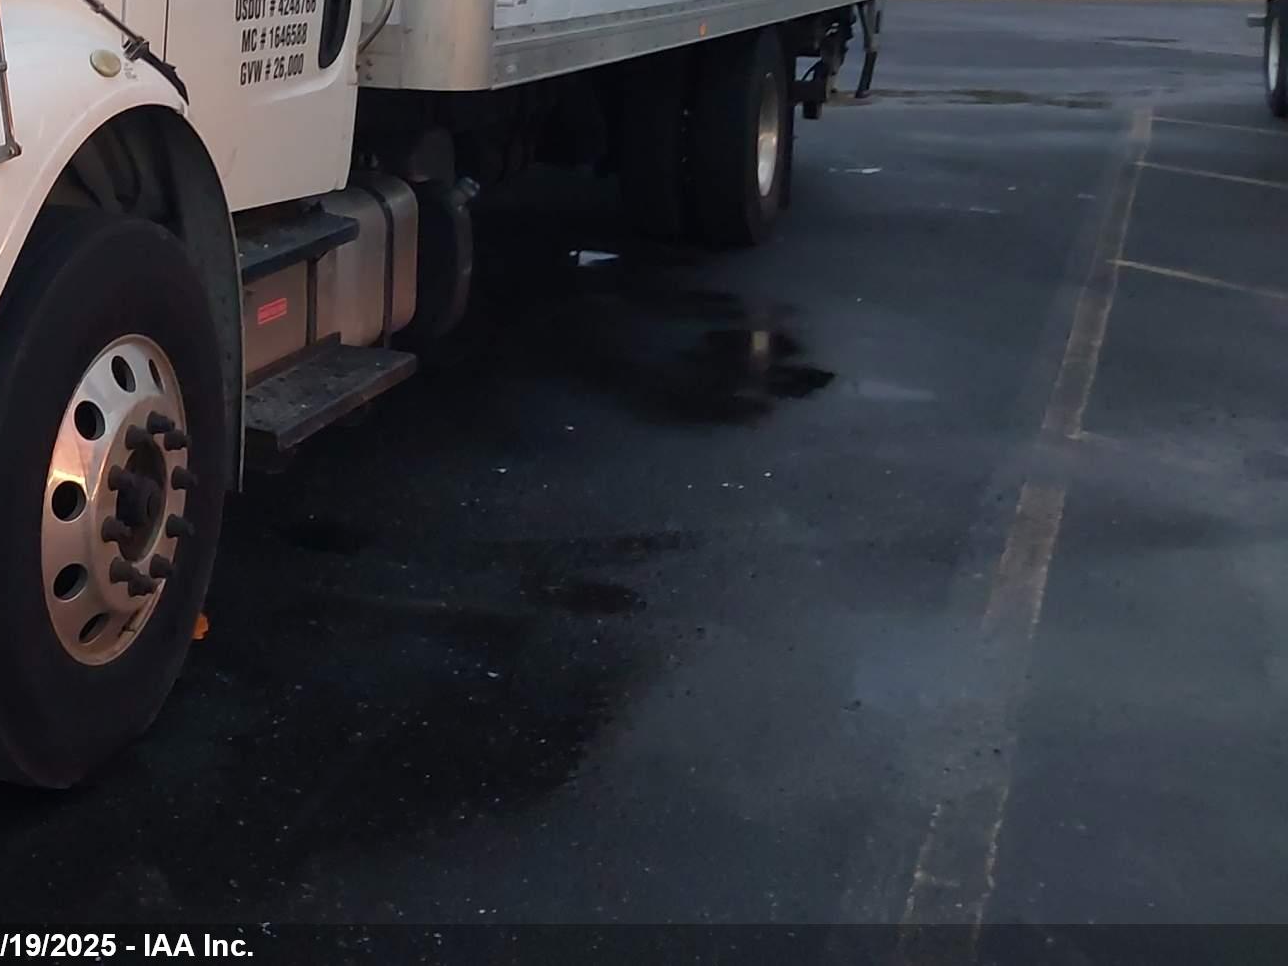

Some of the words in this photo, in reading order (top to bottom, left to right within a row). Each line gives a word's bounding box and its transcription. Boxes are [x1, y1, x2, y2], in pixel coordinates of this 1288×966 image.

[241, 28, 258, 53] MC
[260, 27, 267, 50] #
[240, 59, 263, 86] GVW
[265, 58, 272, 80] #
[273, 53, 304, 81] 26,000
